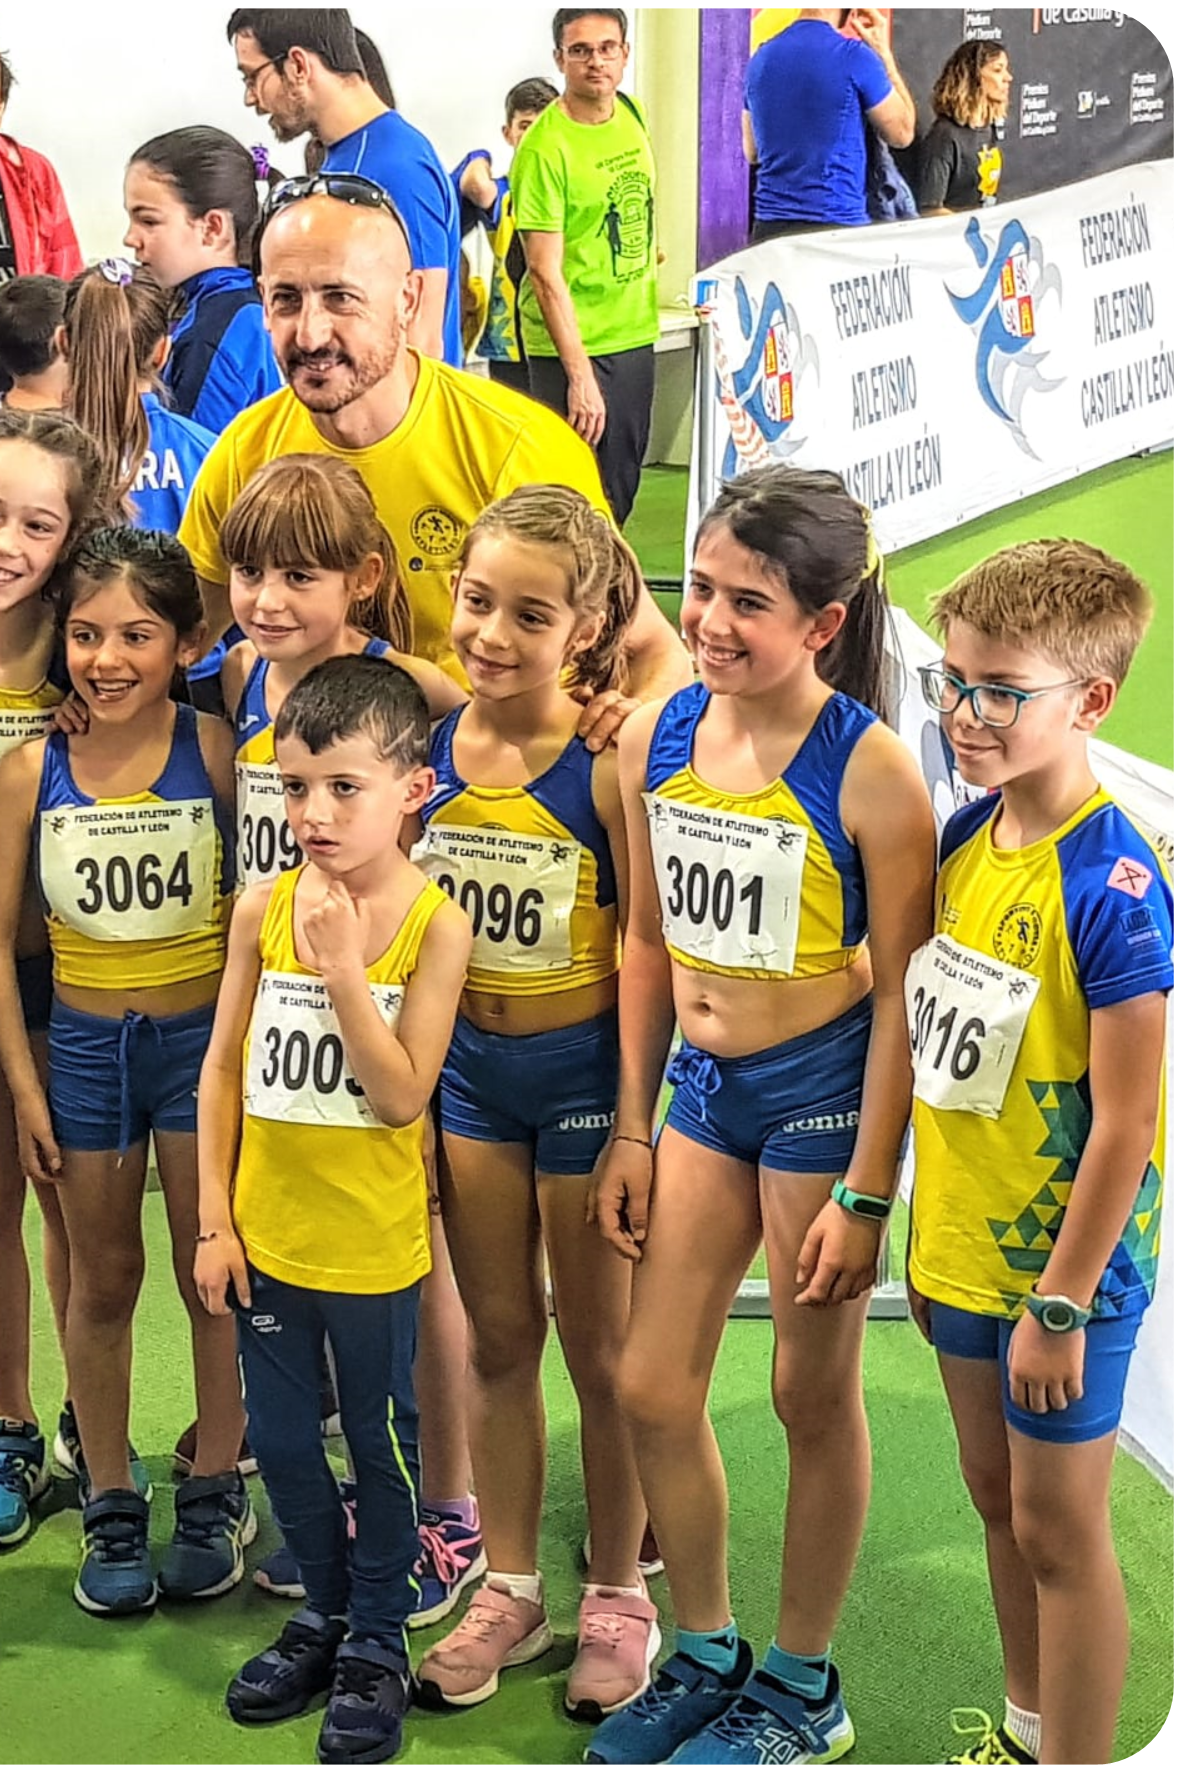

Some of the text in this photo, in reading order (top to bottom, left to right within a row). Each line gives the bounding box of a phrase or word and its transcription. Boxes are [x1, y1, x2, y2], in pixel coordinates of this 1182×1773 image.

[1079, 192, 1151, 268] FEDERACIÓN
[830, 253, 913, 341] FEDERACIÓN
[1094, 281, 1154, 347] ATLETISMO
[852, 355, 917, 431] ATLETISMO
[1081, 365, 1135, 428] CASTILLA
[1134, 360, 1143, 407] Y
[130, 448, 185, 491] RA
[841, 422, 942, 511] ASTILLA Y LEÓN
[5, 715, 16, 724] DE
[18, 729, 23, 737] Y
[74, 808, 183, 824] FEDERACIÓN DE ATLETISMO
[88, 822, 170, 837] DE CASTILLA Y LEÓN
[669, 806, 769, 837] FEDERACIÓN DE ATLETISMO
[242, 813, 304, 874] 309
[438, 831, 543, 852] FEDERACIÓN DE ATLETISMO
[678, 825, 752, 849] DE CASTILLA Y LEÓN
[448, 847, 528, 865] DE CASTILLA Y LEÓN
[75, 850, 193, 914] 3064
[667, 855, 763, 936] 3001
[959, 972, 964, 981] Y
[964, 974, 984, 990] LEÓN
[962, 956, 1004, 980] ATLETISMO
[279, 996, 288, 1005] DE
[290, 997, 326, 1009] CASTILLA
[314, 984, 325, 994] DE
[911, 986, 986, 1081] 3016
[262, 1026, 365, 1097] 300
